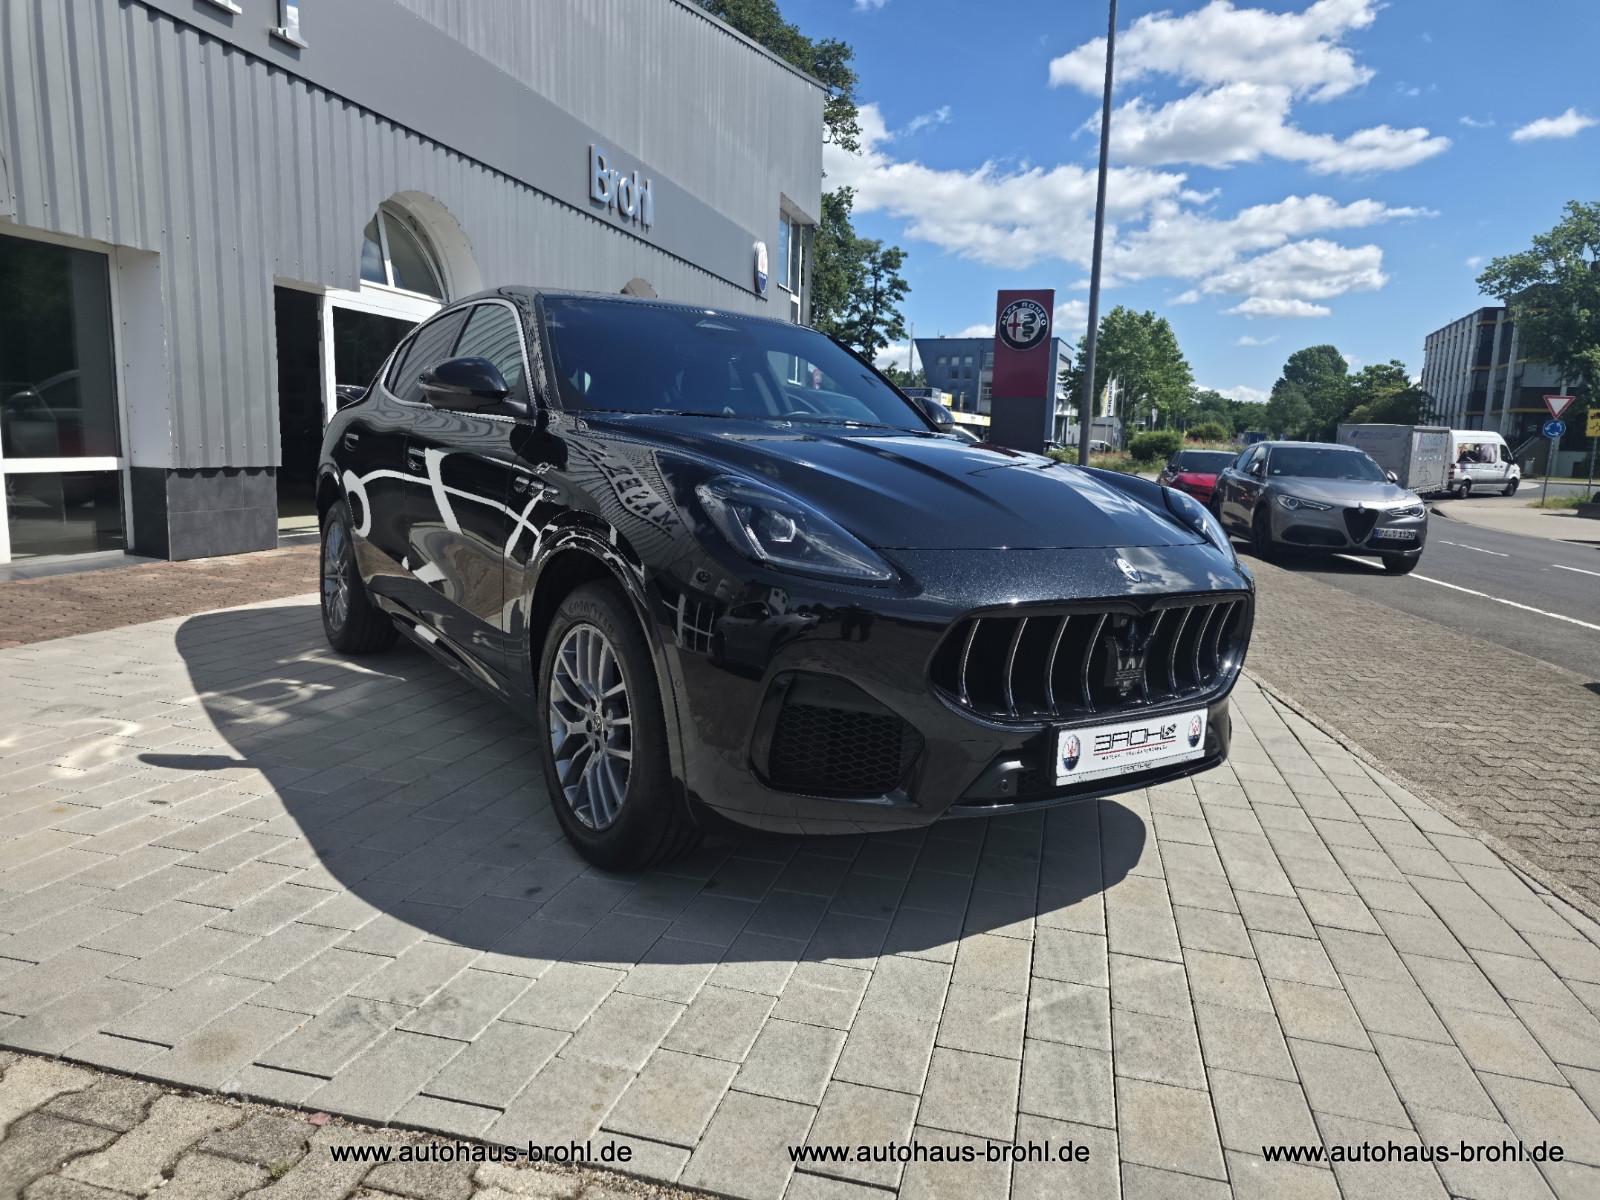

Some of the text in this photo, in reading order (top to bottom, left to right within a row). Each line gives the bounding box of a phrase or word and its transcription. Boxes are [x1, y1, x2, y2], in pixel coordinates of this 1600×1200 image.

[588, 143, 654, 229] Brohl
[1001, 301, 1047, 326] ALFA ROMEO
